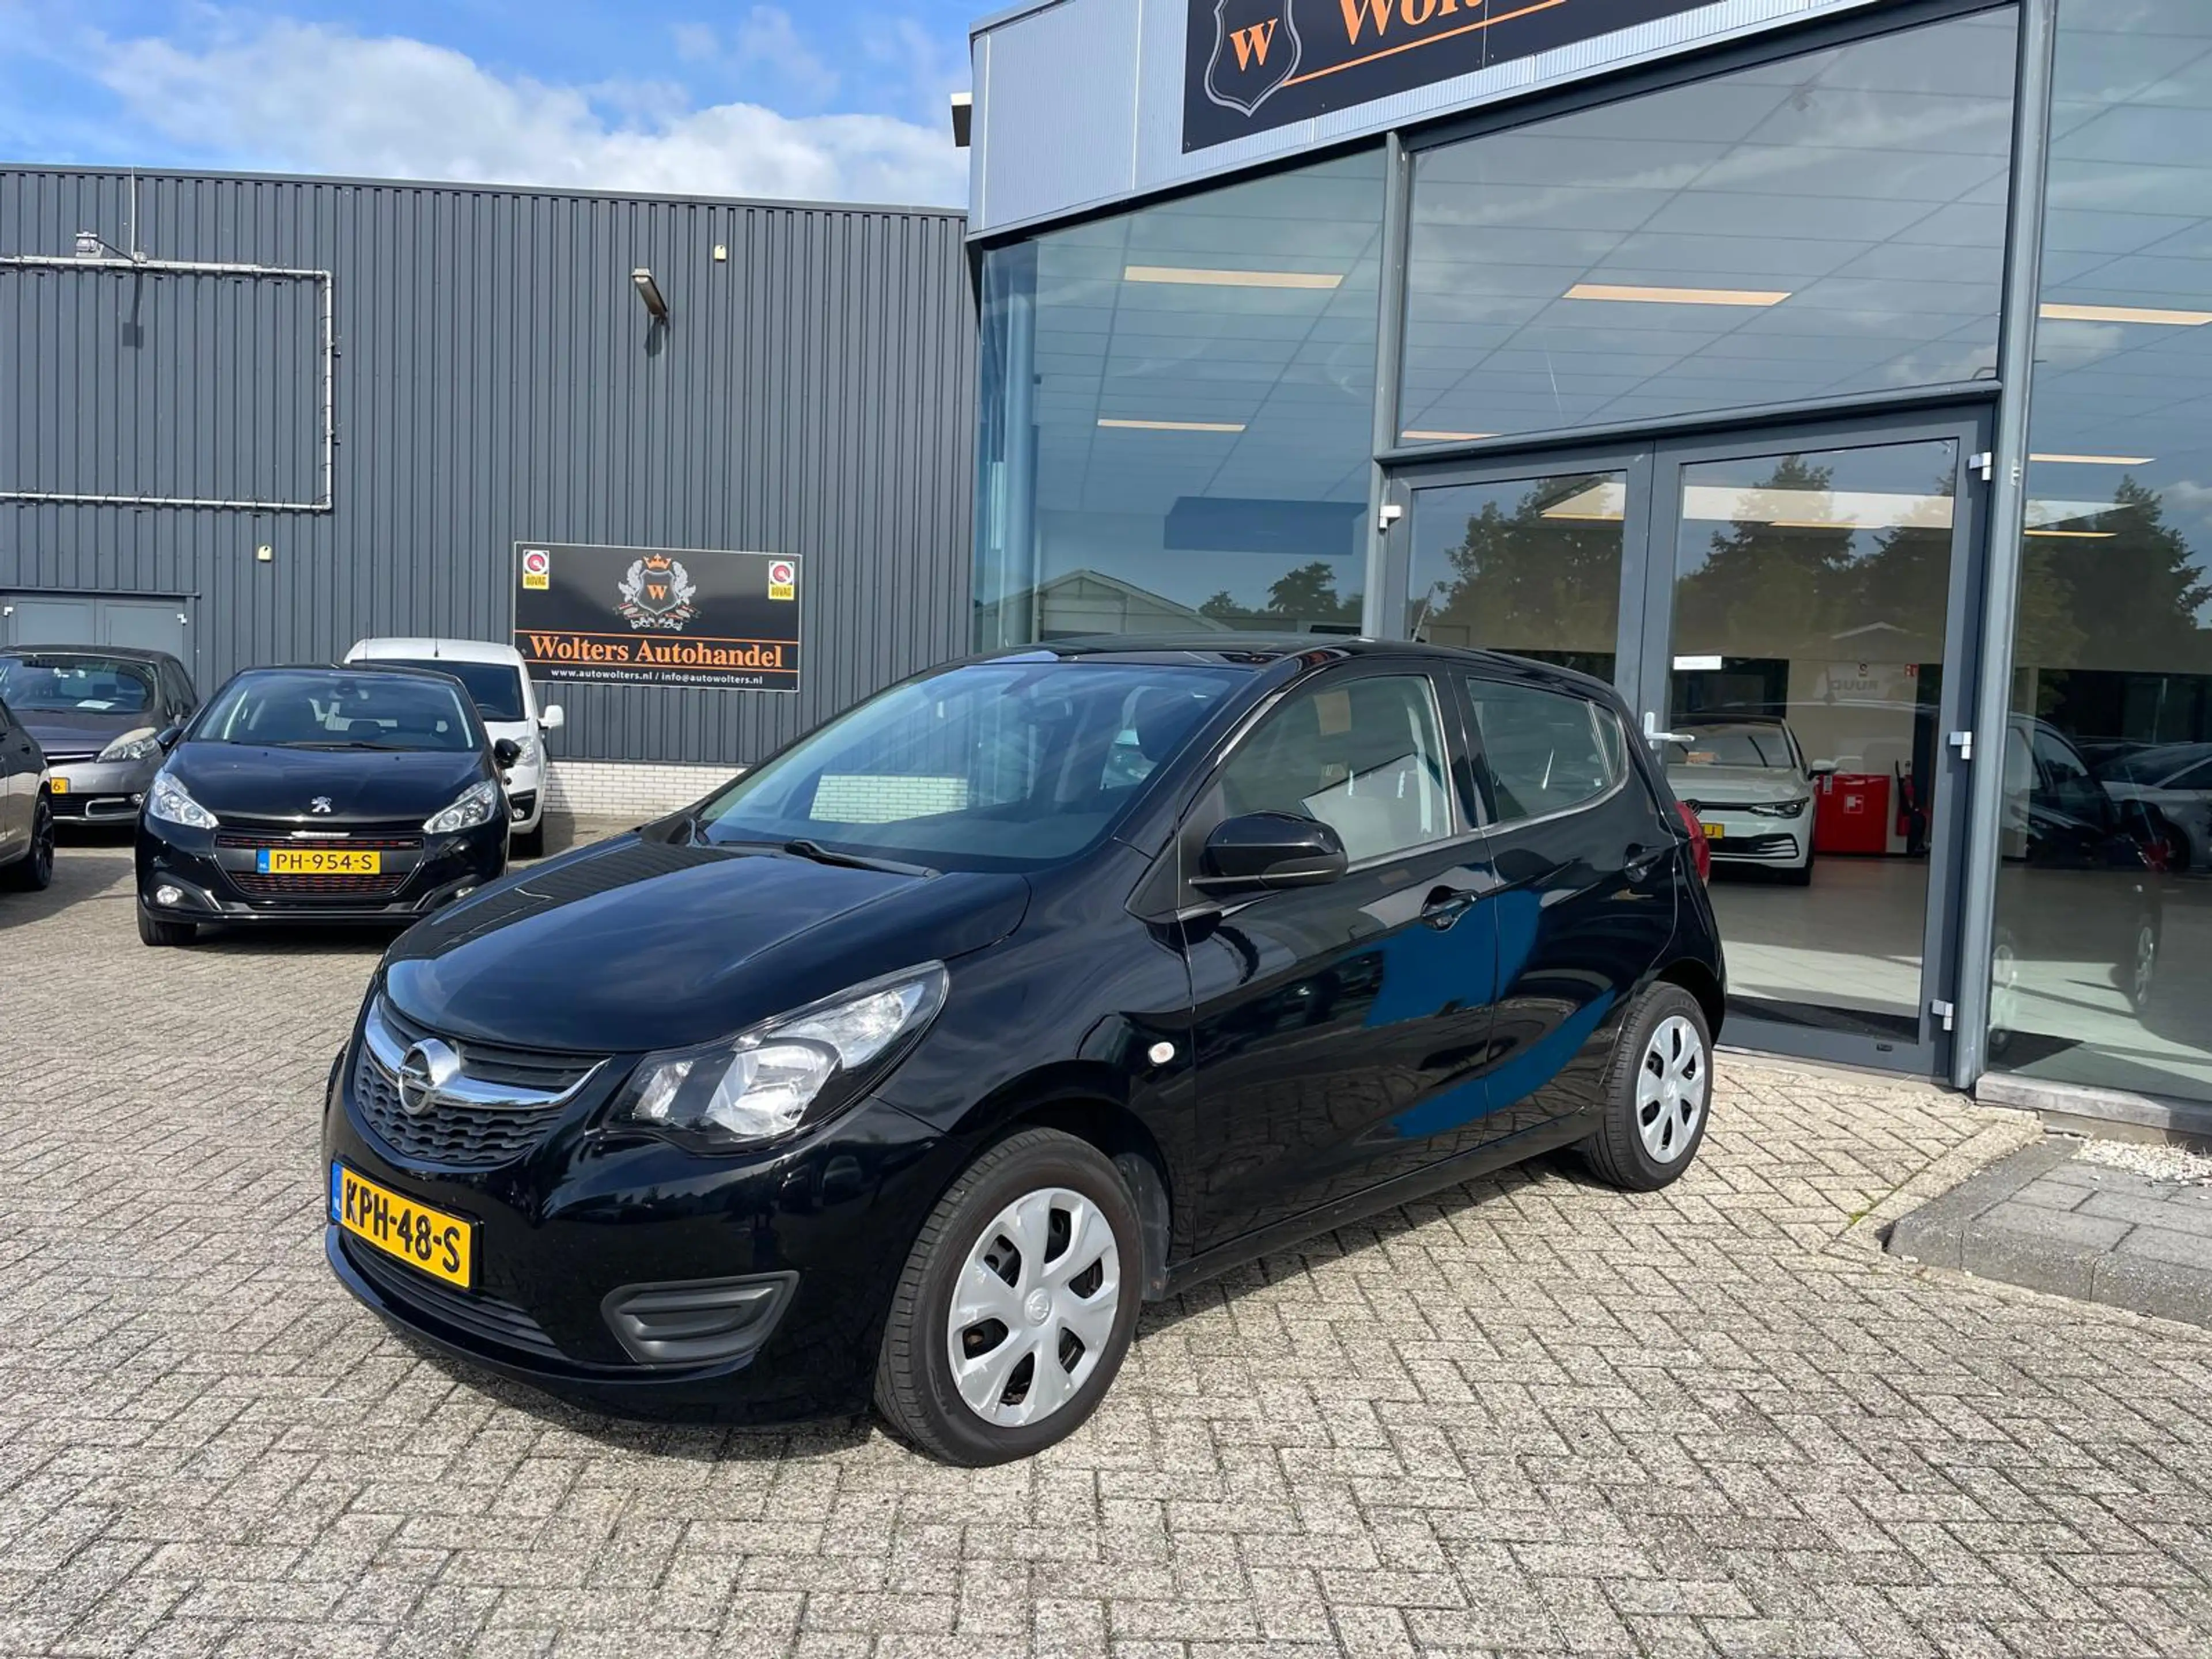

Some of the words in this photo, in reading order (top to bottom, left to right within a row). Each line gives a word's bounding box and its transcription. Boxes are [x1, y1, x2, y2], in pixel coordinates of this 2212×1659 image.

[1229, 18, 1278, 71] W
[647, 584, 668, 600] W
[529, 635, 629, 661] Wolters
[634, 639, 783, 668] Autohandel
[551, 668, 652, 680] www.autowolters.nl
[661, 671, 763, 685] info@autowolters.nl
[276, 854, 372, 870] PH-954-S
[346, 1177, 460, 1273] KPH-48-S
